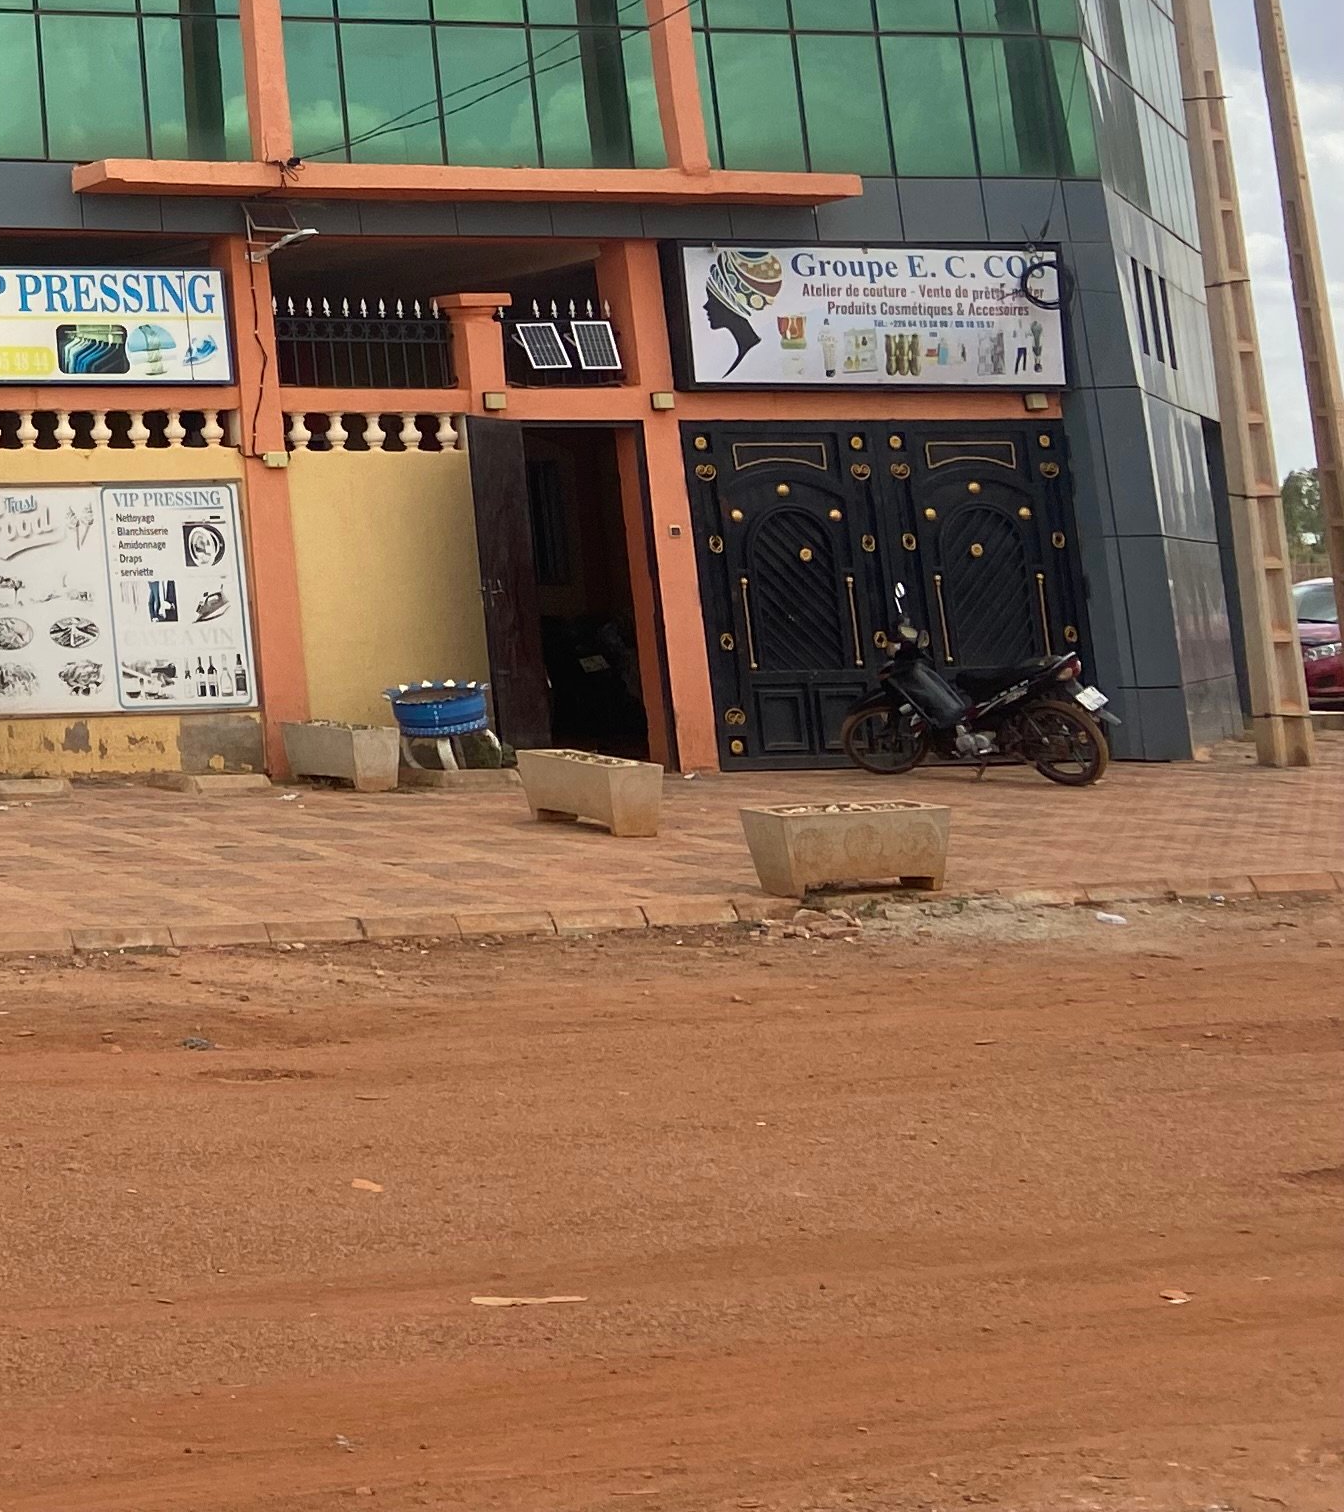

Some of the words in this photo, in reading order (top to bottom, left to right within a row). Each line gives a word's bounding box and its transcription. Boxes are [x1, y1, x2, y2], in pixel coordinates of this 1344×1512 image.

[791, 252, 899, 284] Groupe
[15, 274, 215, 314] PRESSING
[802, 283, 842, 297] Atelier
[846, 283, 859, 297] de
[863, 286, 907, 298] couture
[919, 285, 951, 298] Vente
[955, 285, 968, 299] de
[827, 301, 877, 316] Produits
[880, 301, 953, 318] Cosmétiques
[957, 302, 965, 316] &
[968, 303, 1030, 316] Accessoires
[112, 492, 139, 508] VIP
[143, 490, 221, 508] PRESSING
[115, 513, 155, 524] Nettoyage
[117, 526, 168, 536] Blanchisserie
[118, 540, 166, 551] Amidonnage
[119, 553, 143, 564] Draps
[120, 568, 154, 576] serviette
